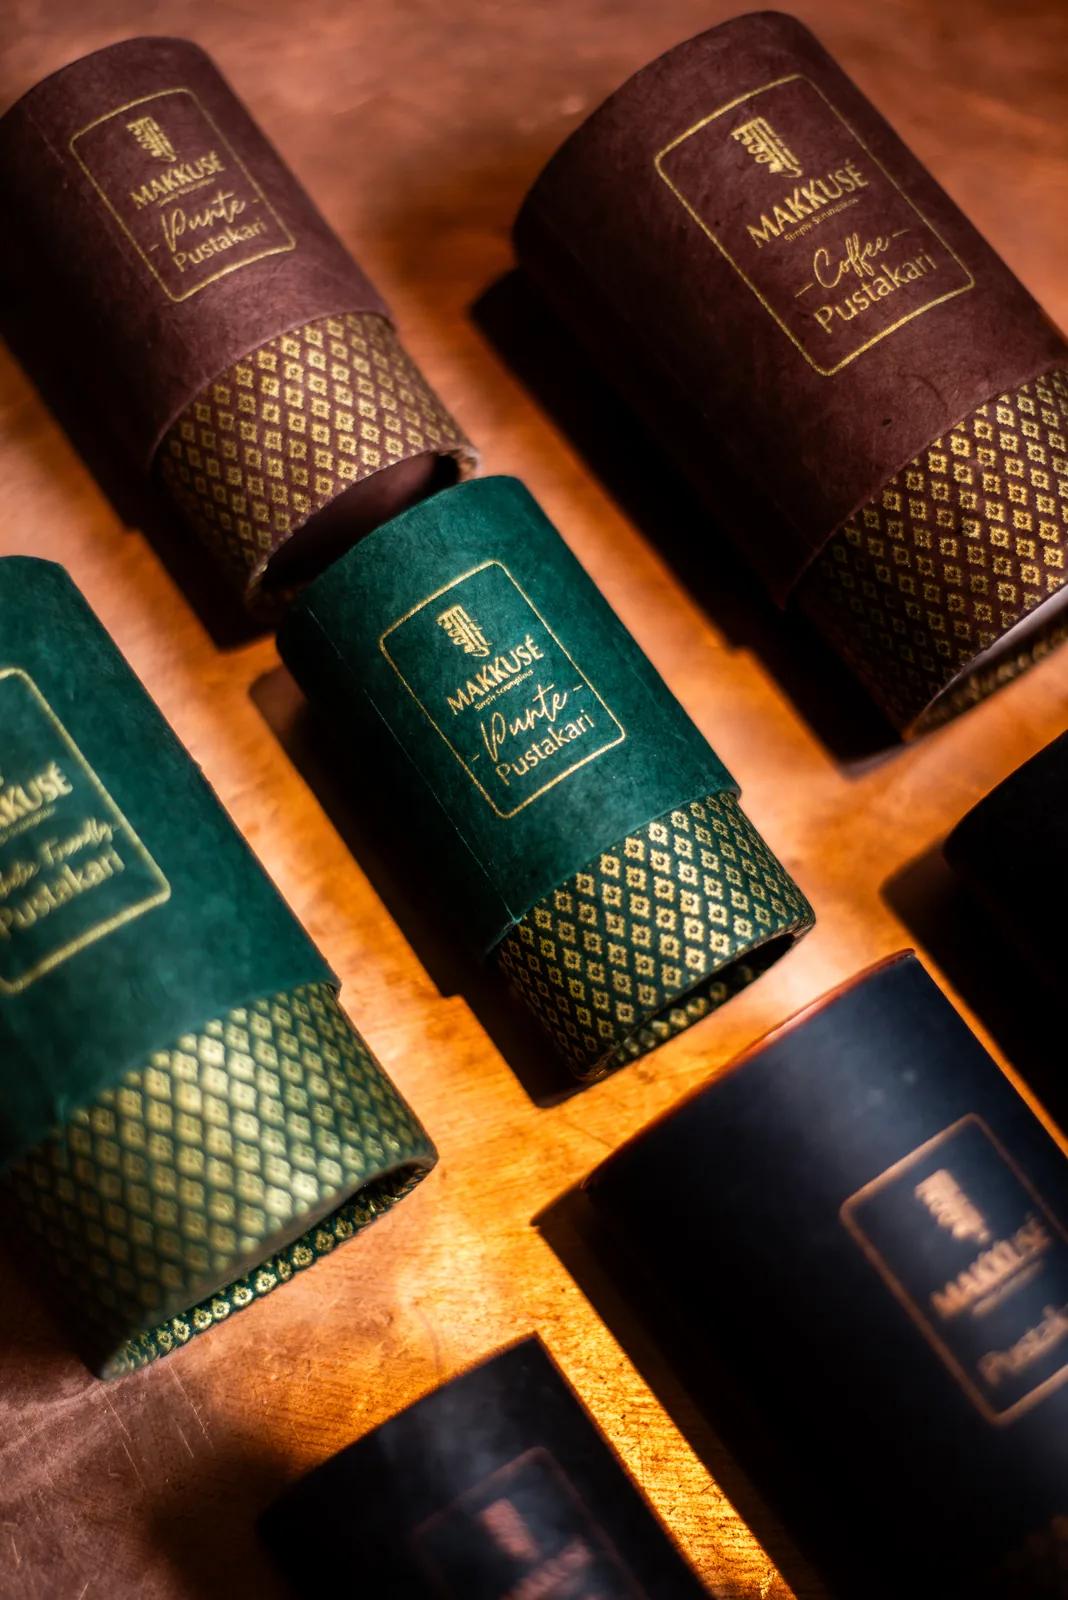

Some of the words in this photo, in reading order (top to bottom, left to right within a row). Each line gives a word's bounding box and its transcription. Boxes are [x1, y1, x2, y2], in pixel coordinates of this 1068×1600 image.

[172, 216, 269, 273] Pustakari
[813, 232, 889, 288] Coffee
[813, 248, 937, 334] Pustakari
[495, 709, 596, 786] Pustakari
